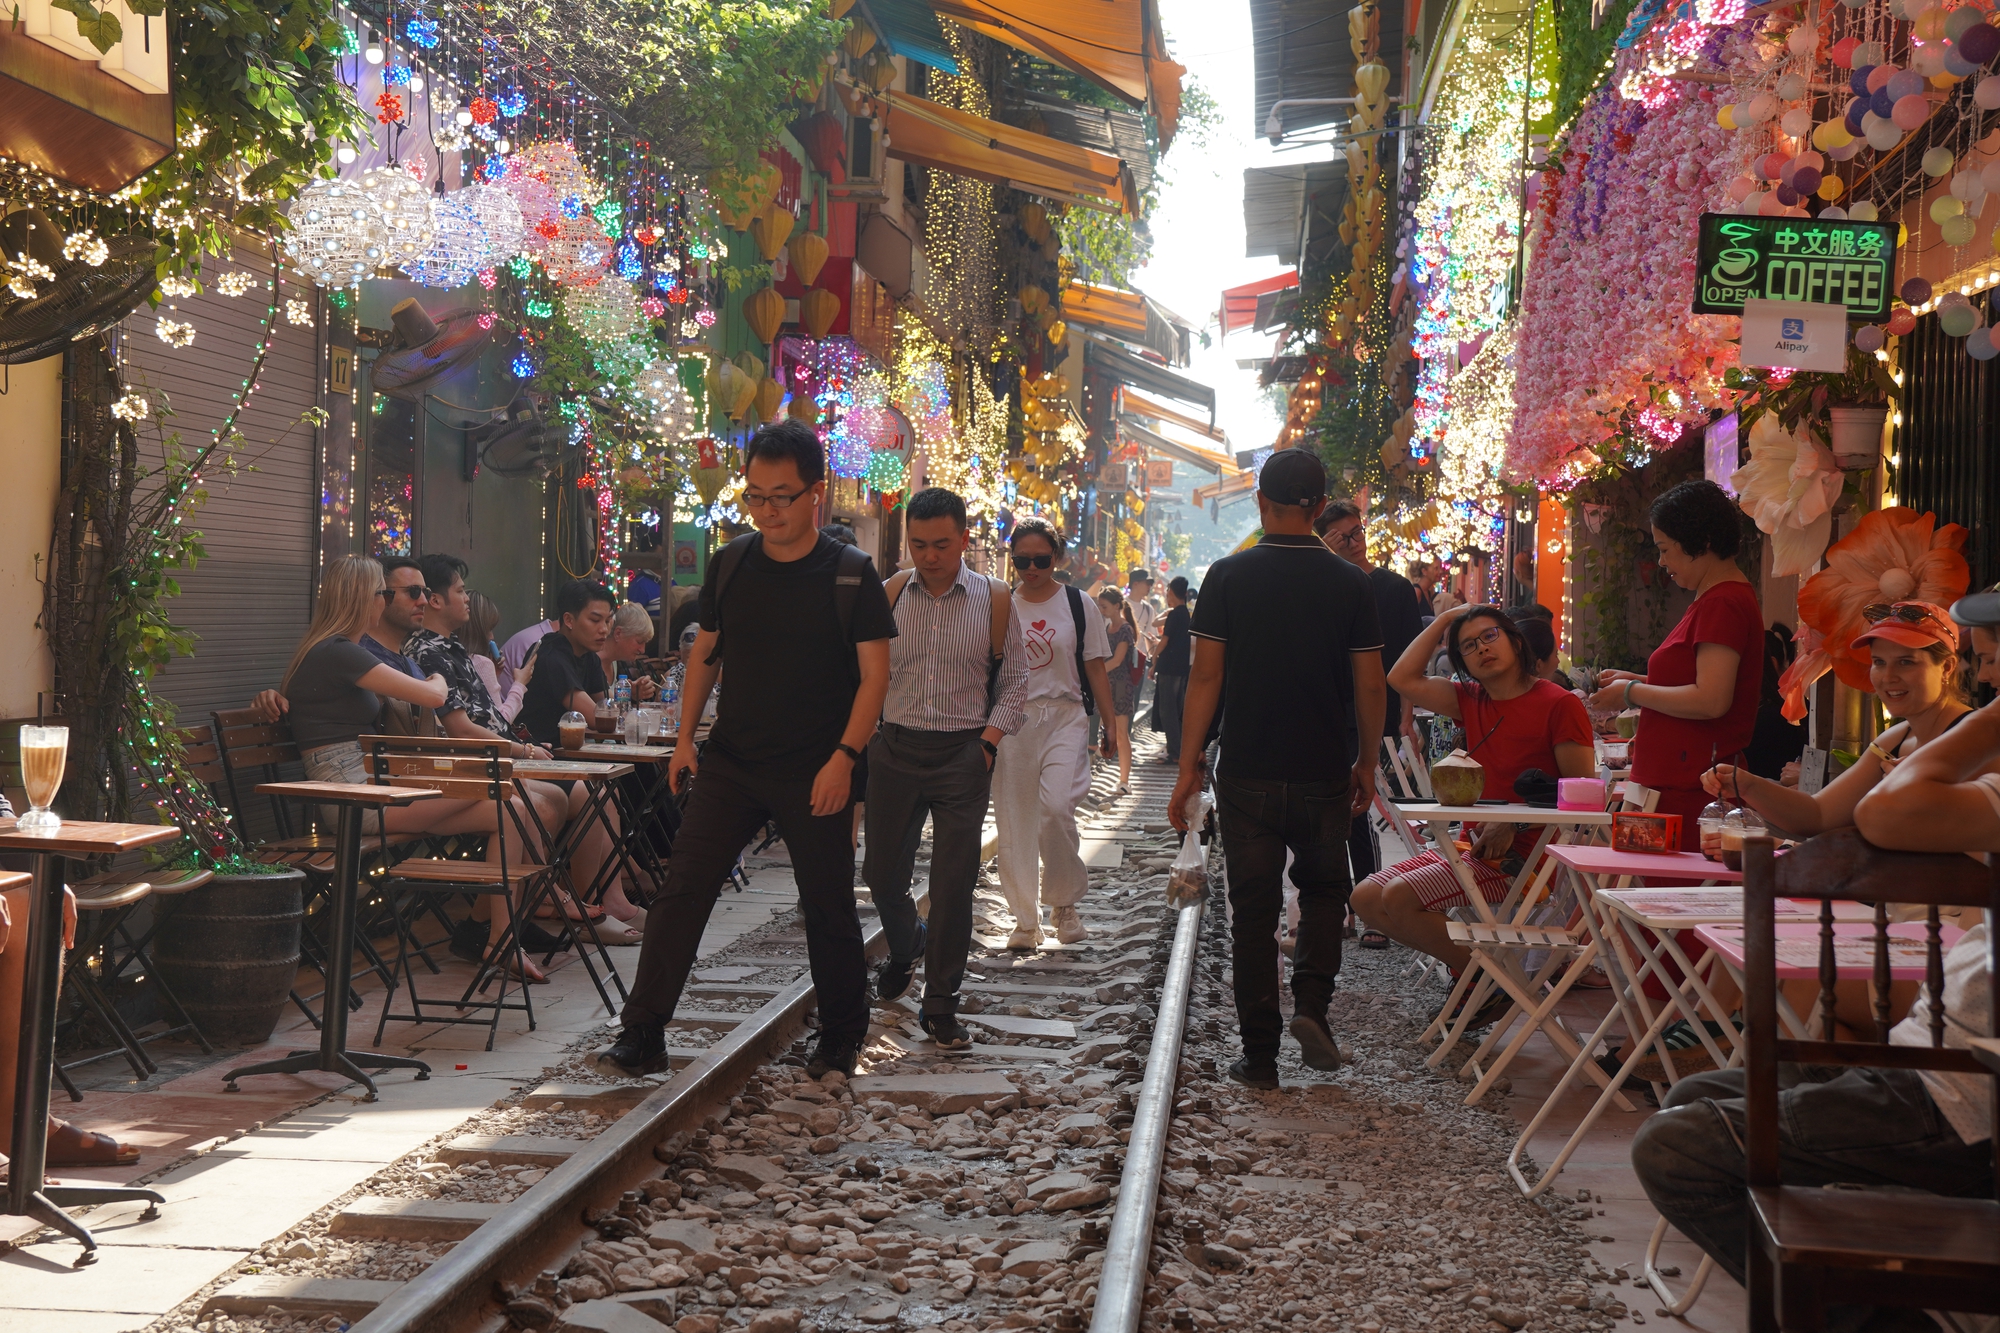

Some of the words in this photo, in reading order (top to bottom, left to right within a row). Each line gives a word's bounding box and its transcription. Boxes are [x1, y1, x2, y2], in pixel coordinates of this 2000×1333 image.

[1774, 227, 1884, 258] 中文服务
[1707, 287, 1759, 302] OPEN
[1765, 260, 1882, 306] COFFEE
[1774, 341, 1809, 353] Alipay
[335, 356, 347, 384] 17
